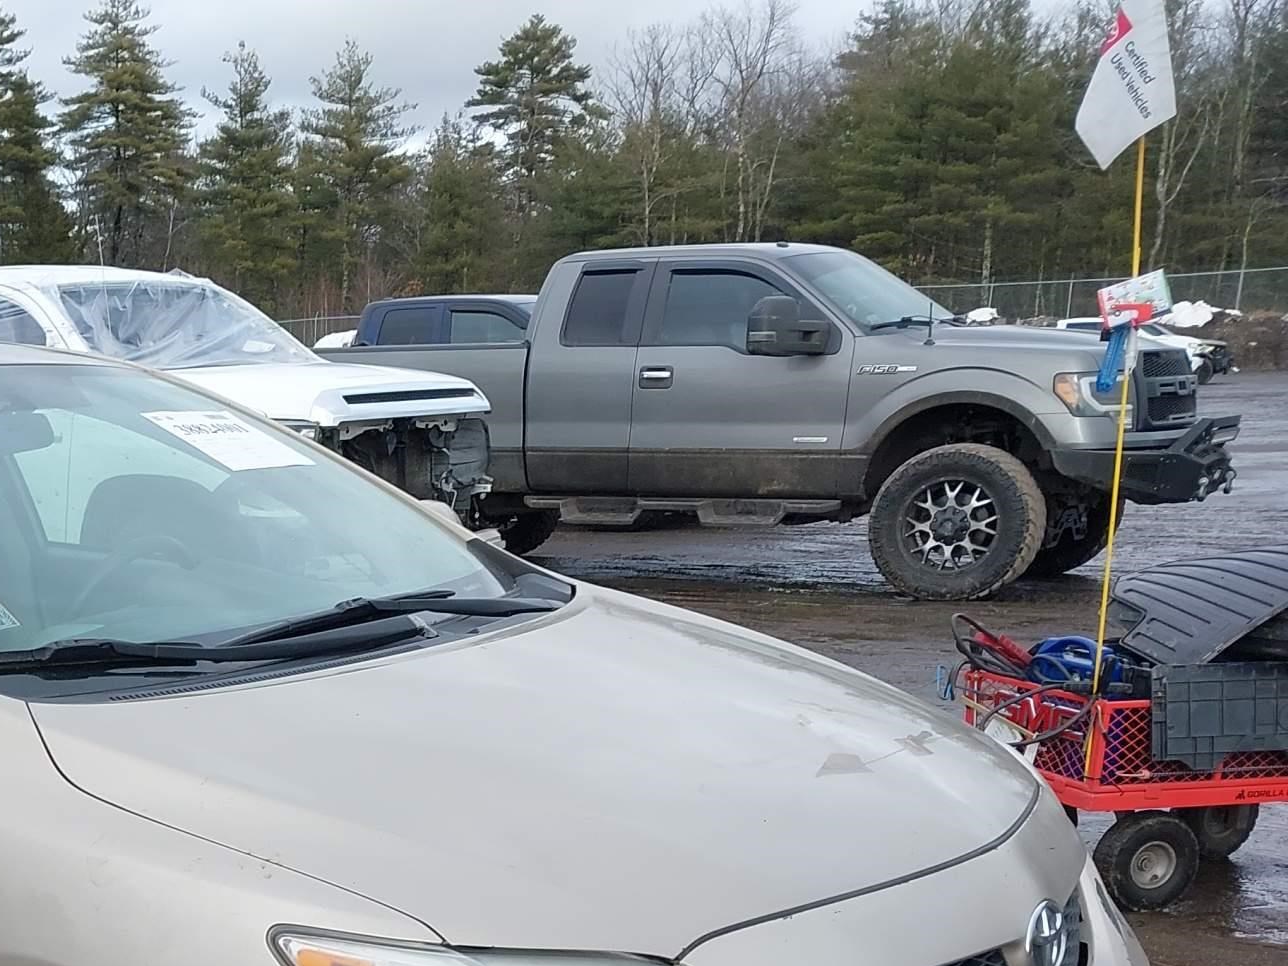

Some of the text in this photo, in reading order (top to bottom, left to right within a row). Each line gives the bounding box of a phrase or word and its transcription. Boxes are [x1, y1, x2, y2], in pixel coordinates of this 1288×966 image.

[1124, 40, 1157, 85] Certified
[1110, 52, 1153, 120] Used Vehicles
[1247, 789, 1284, 799] GORILLA
